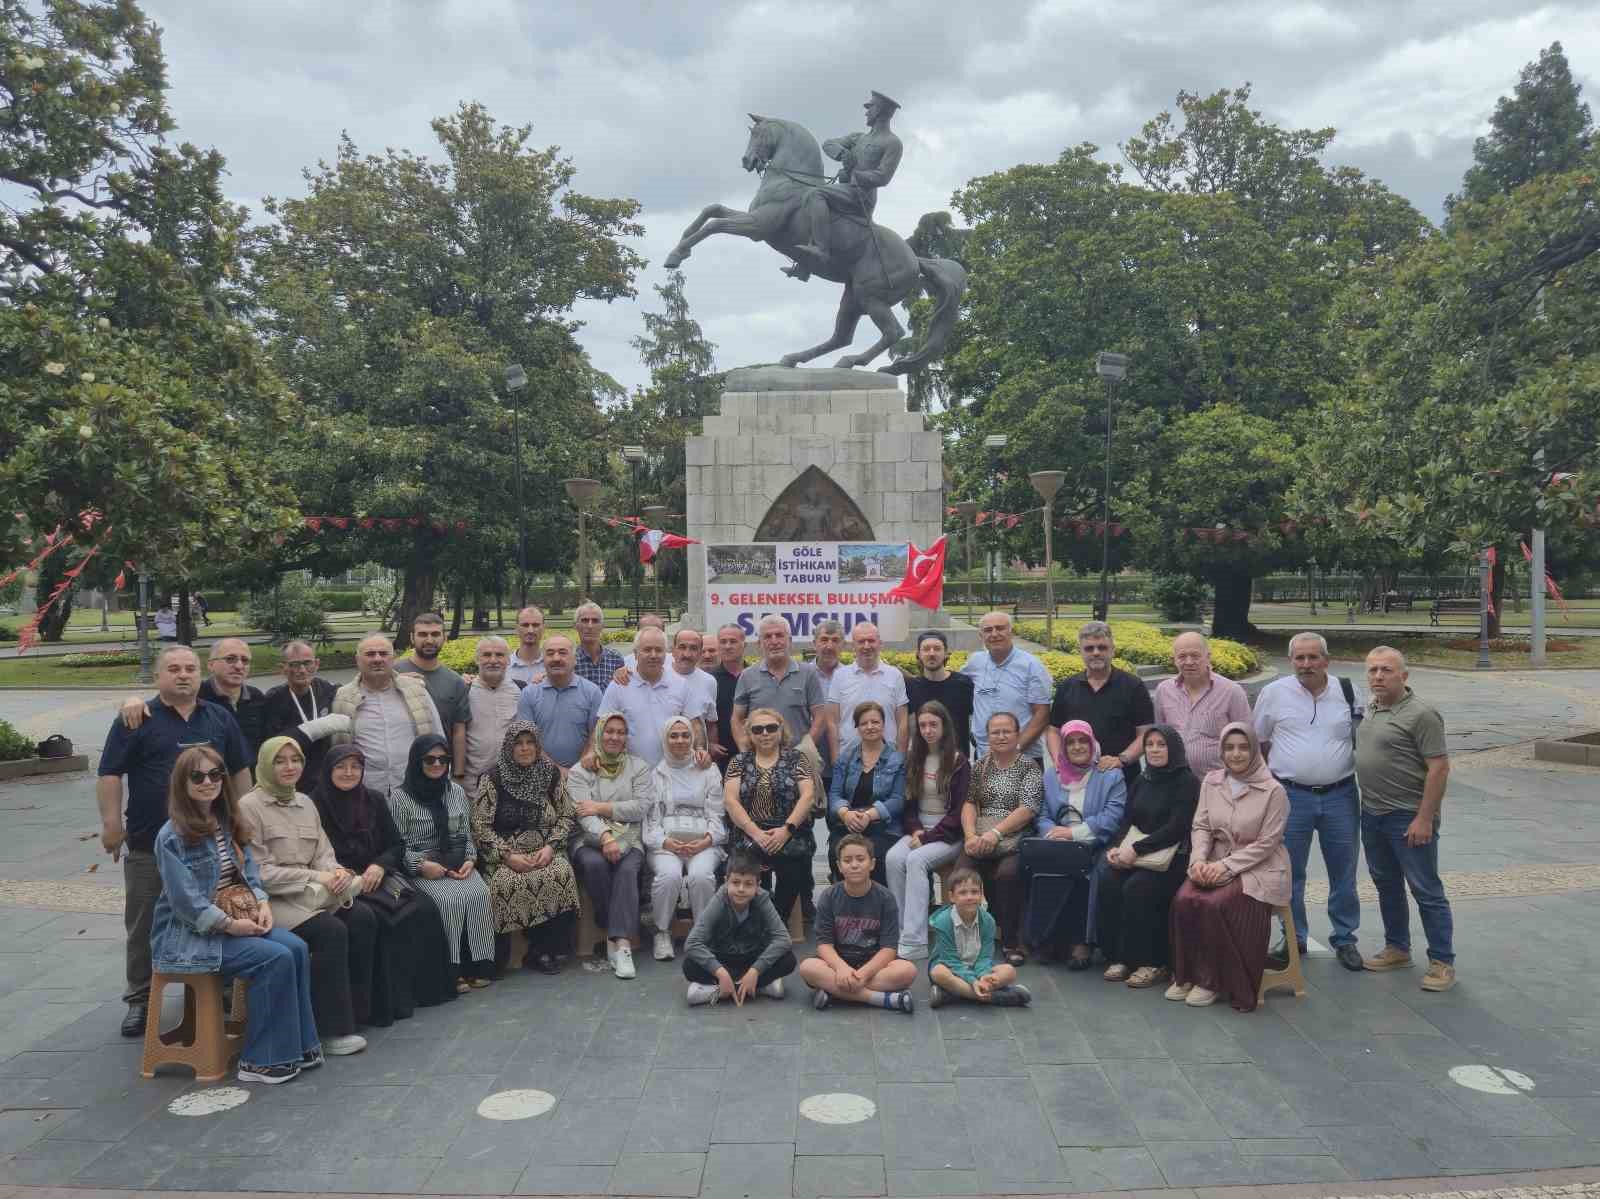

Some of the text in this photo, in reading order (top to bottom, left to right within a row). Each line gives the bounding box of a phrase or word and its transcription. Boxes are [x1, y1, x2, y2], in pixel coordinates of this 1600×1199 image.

[792, 545, 823, 557] GÖLE
[778, 558, 837, 570] İSTİHKAM
[784, 574, 832, 584] TABURU
[710, 593, 725, 605] 9.
[728, 592, 823, 606] GELENEKSEL
